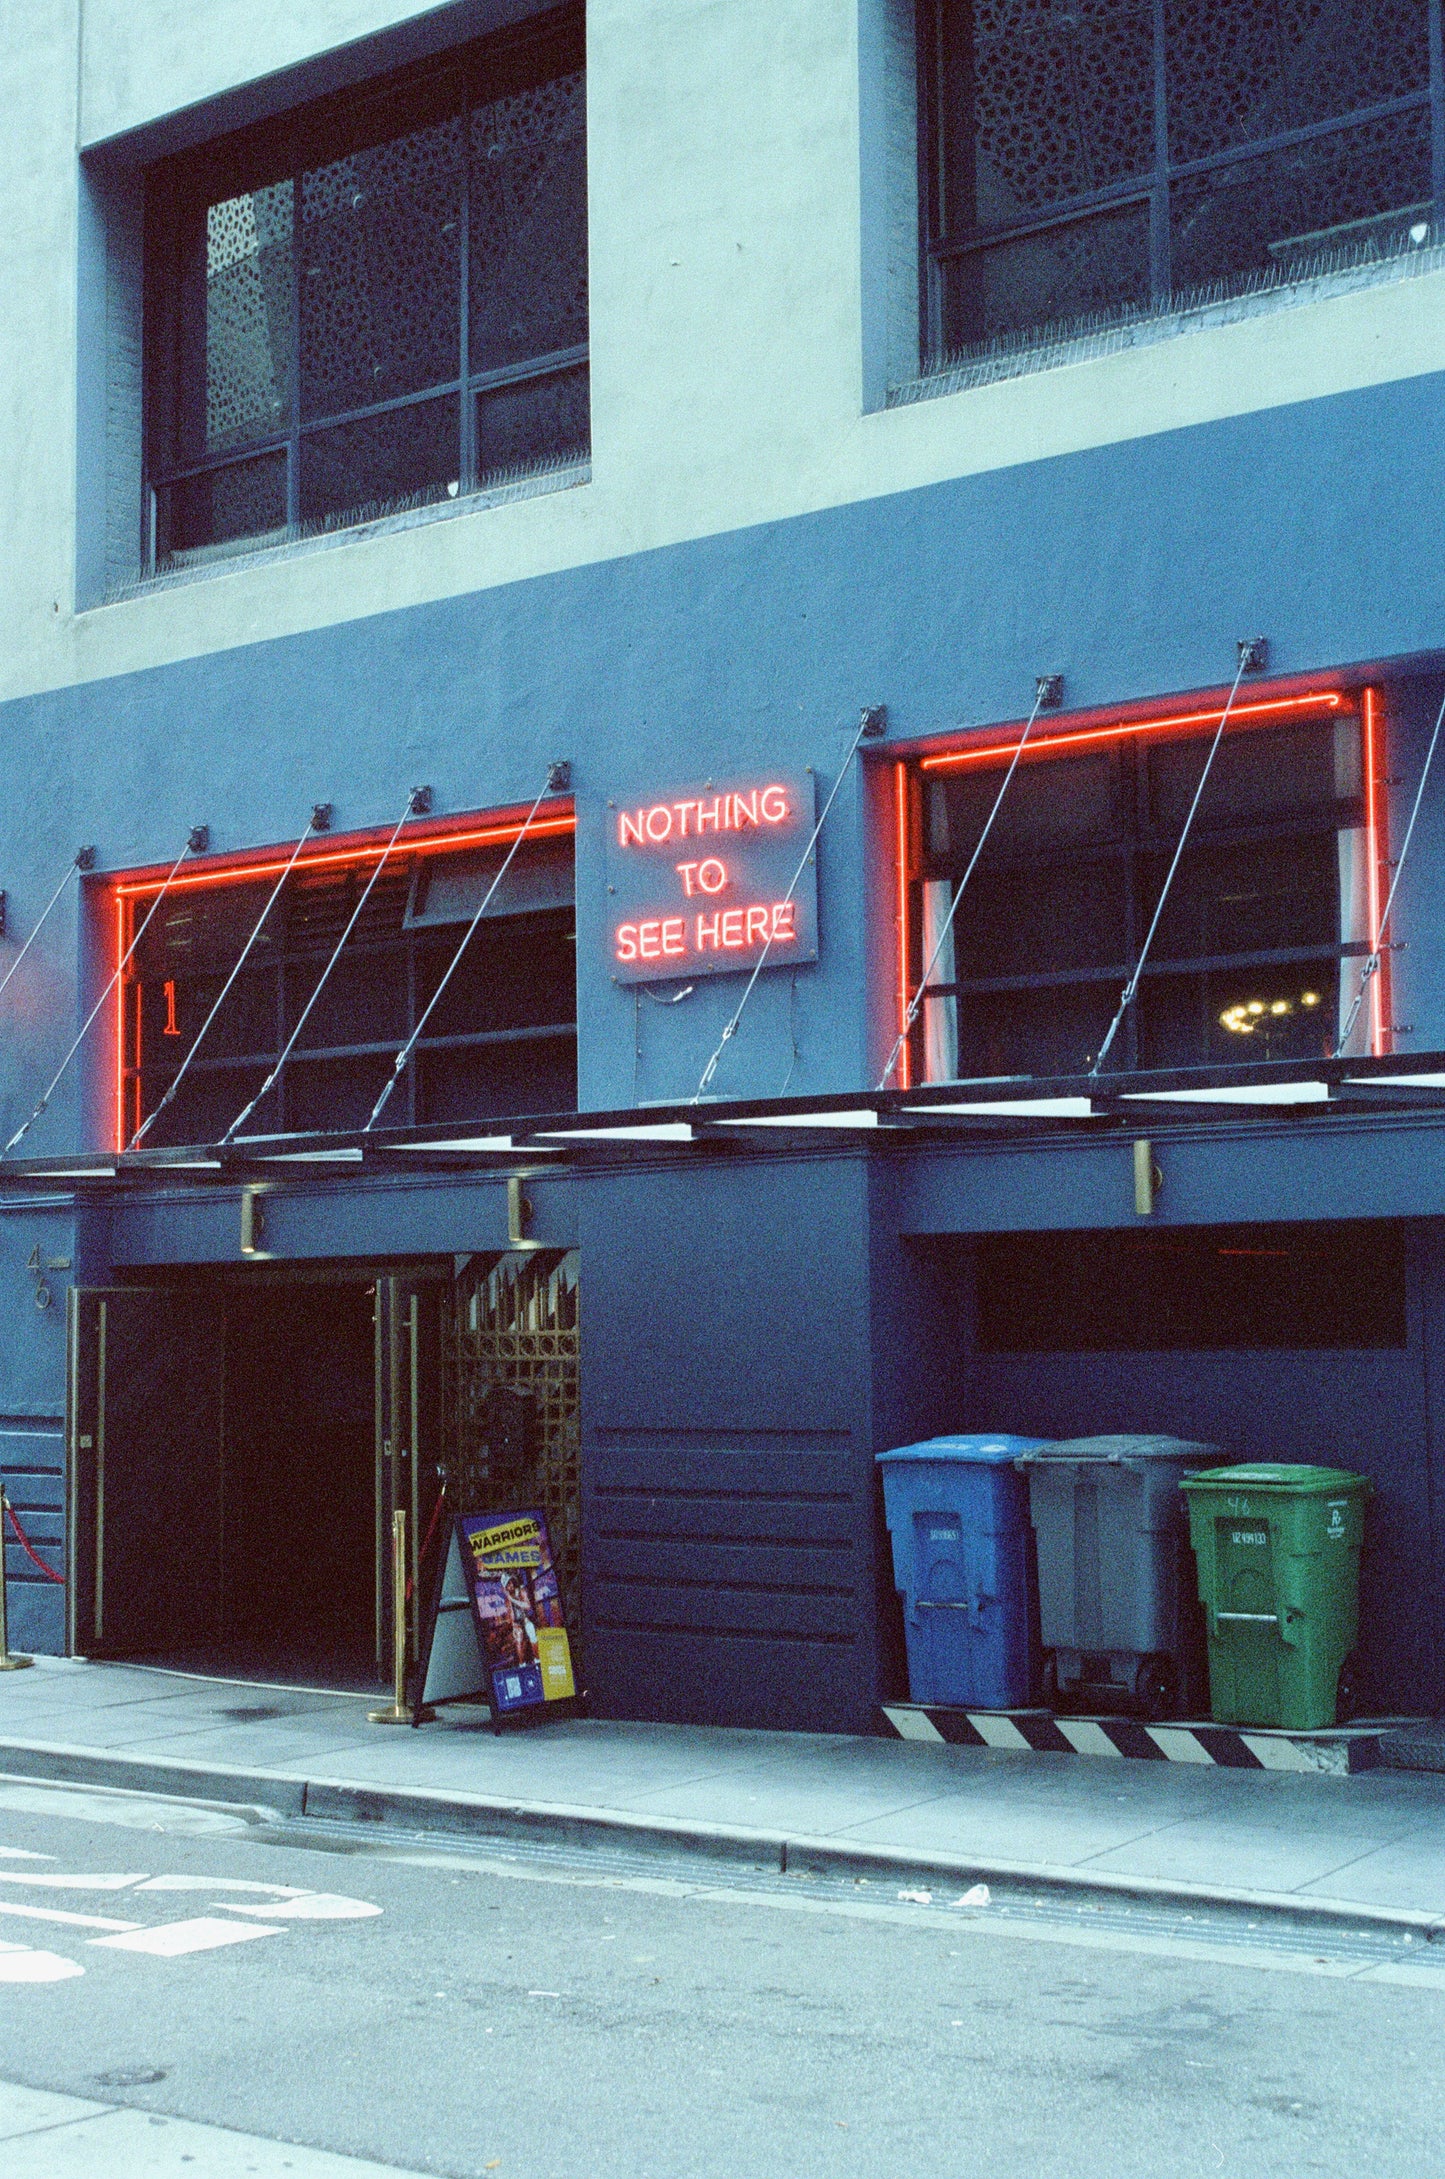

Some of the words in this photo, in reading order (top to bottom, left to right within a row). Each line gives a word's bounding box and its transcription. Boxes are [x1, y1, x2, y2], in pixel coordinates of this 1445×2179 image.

[617, 785, 787, 846] NOTHING
[676, 858, 726, 896] TO
[616, 917, 685, 960] SEE
[696, 902, 795, 950] HERE
[469, 1521, 541, 1552] WARRIORS
[482, 1549, 541, 1564] GAMES
